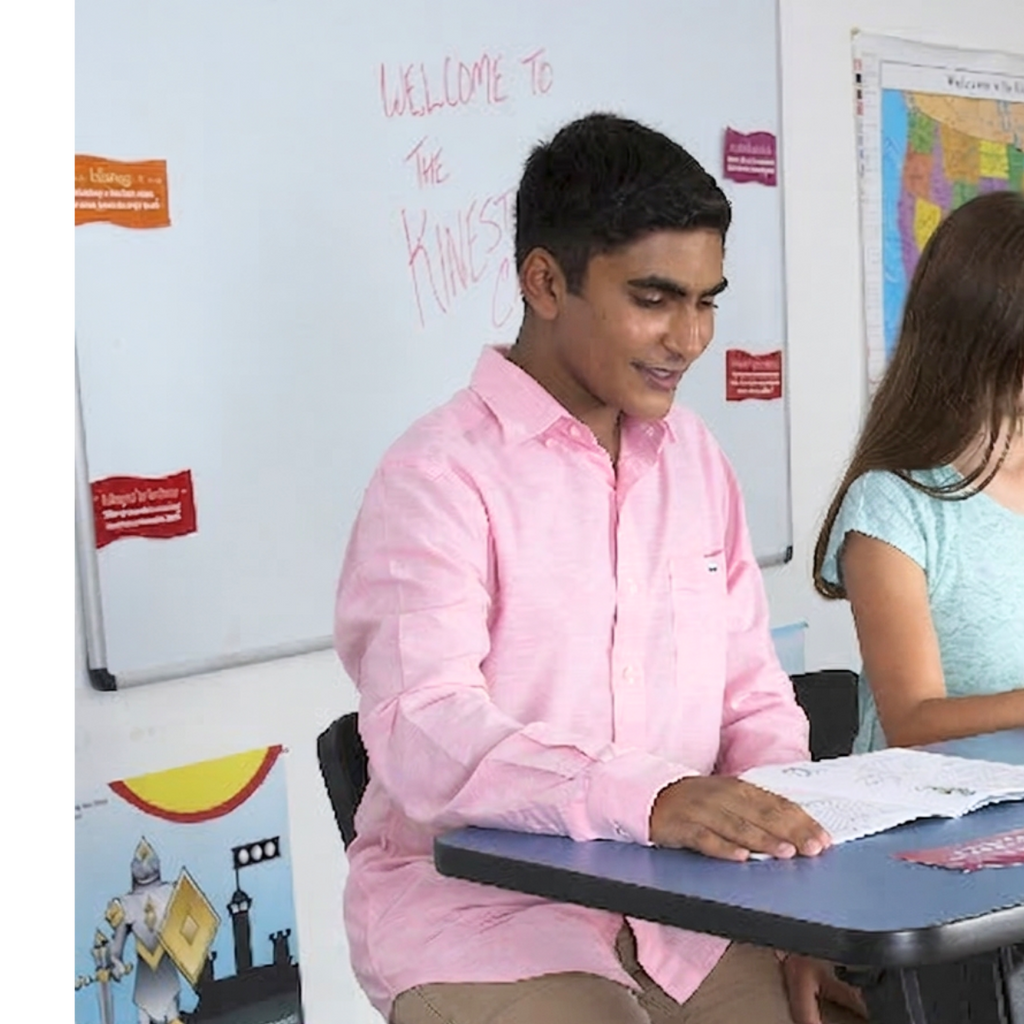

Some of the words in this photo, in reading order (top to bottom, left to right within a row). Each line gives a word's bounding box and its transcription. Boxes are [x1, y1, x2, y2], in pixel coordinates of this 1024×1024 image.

[380, 53, 508, 118] WELCOME
[522, 48, 553, 95] TO
[405, 134, 450, 188] THE
